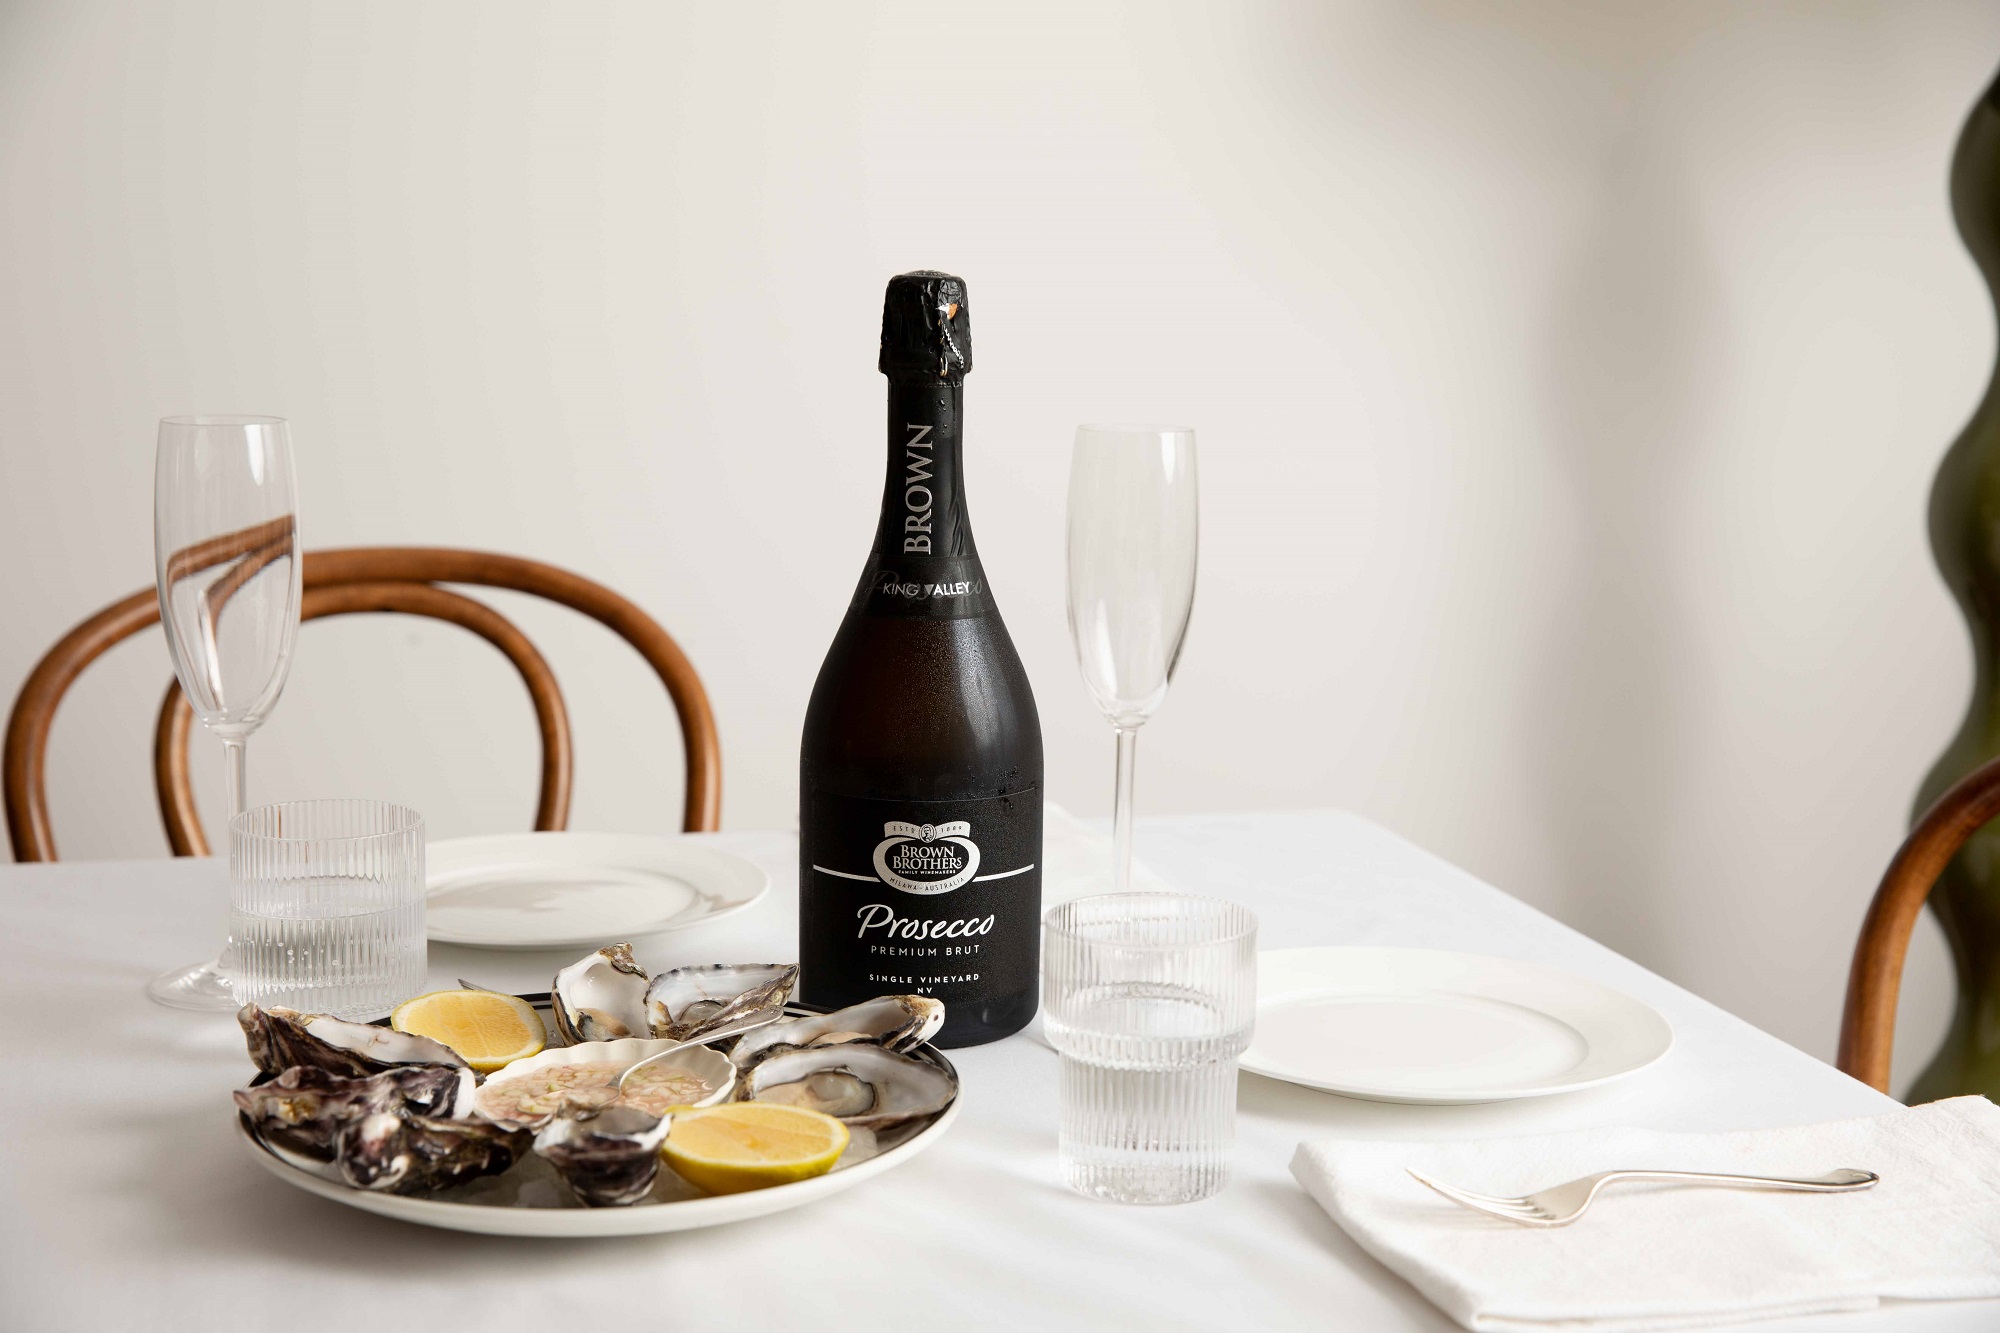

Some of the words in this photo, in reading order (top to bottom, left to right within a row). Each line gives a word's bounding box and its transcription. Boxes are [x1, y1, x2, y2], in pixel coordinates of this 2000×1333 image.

[903, 422, 934, 555] BROWN
[882, 582, 919, 596] KING
[924, 581, 970, 596] VALLEY
[900, 844, 955, 858] BROWN
[892, 855, 963, 870] BROTHERS
[889, 877, 917, 890] MILAWA
[924, 877, 965, 892] AUSTRALIA
[856, 903, 995, 941] Prosecco
[870, 945, 937, 957] PREMIUM
[945, 944, 980, 956] BRUT
[869, 973, 913, 984] SINGLE
[920, 973, 980, 984] VINEYARD
